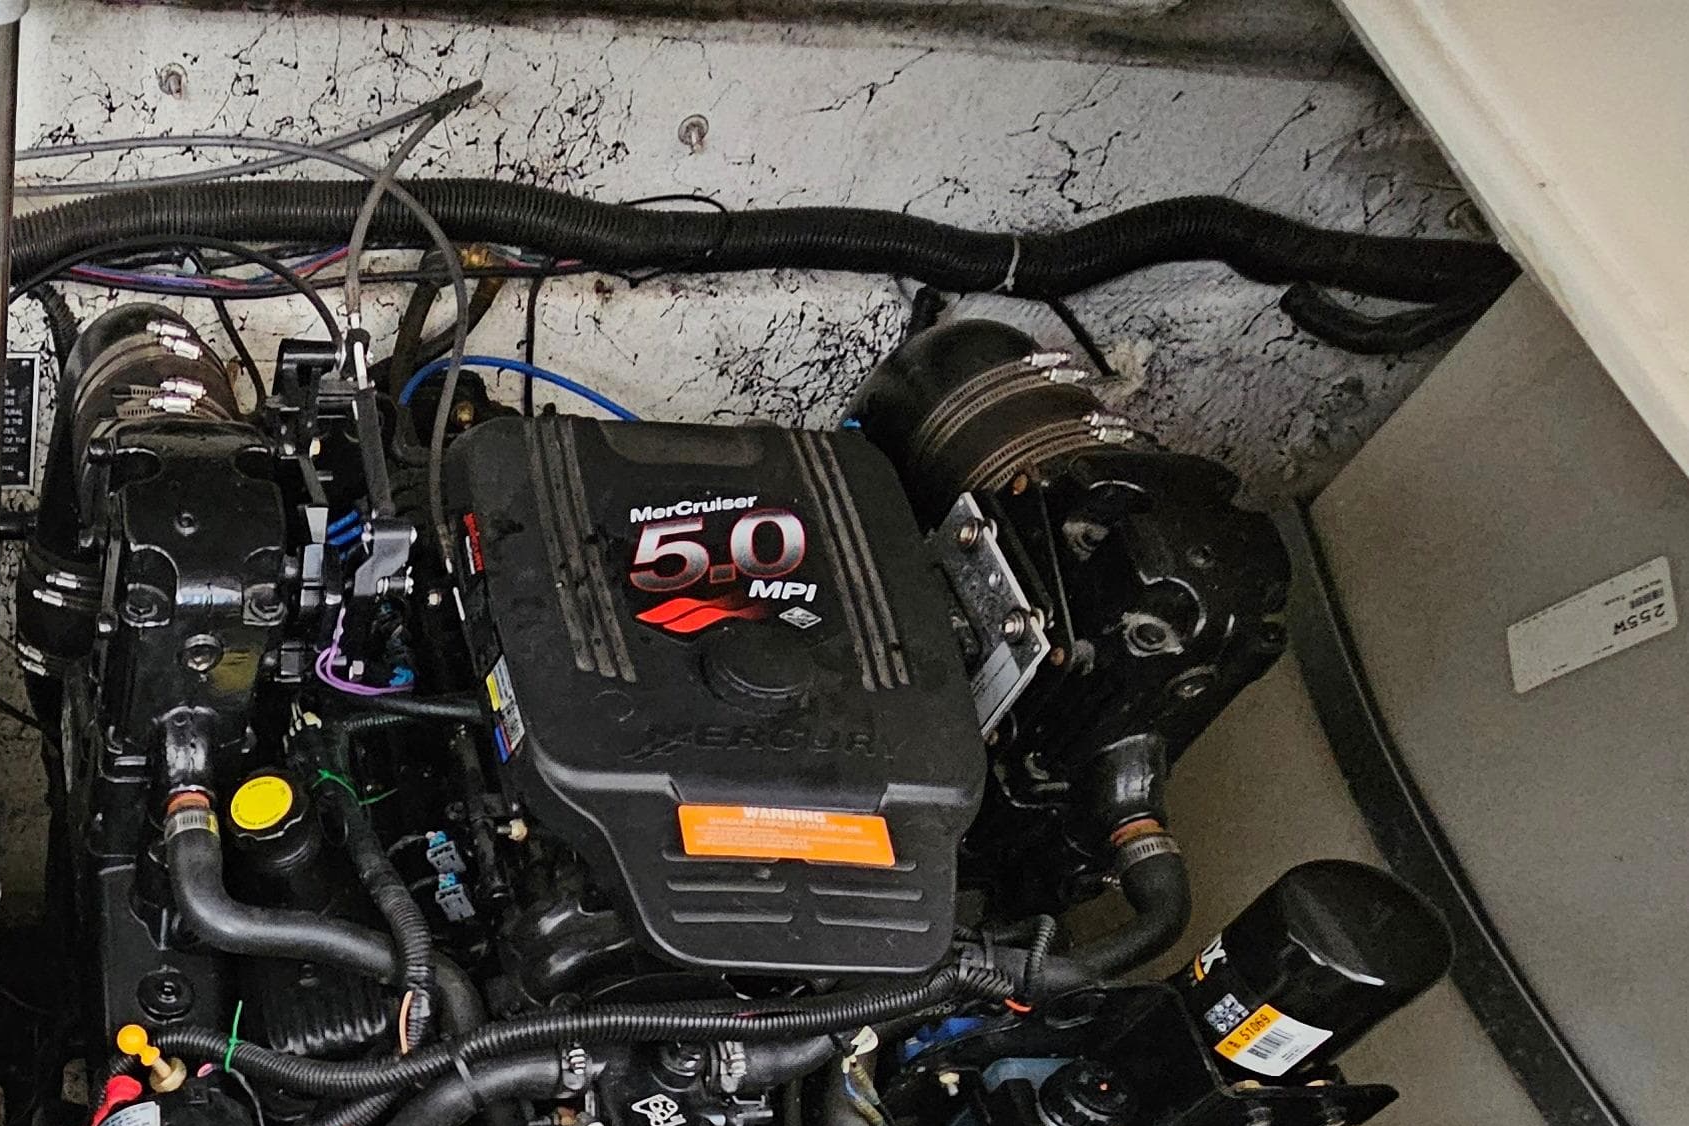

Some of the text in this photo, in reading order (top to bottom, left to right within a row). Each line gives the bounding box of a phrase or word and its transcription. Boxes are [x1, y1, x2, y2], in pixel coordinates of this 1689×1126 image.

[630, 495, 758, 524] MerCruiser
[629, 508, 807, 592] 5.0
[748, 579, 818, 602] MPI
[1613, 602, 1666, 636] 255W
[742, 806, 826, 824] WARNING
[1239, 1013, 1272, 1042] 51069
